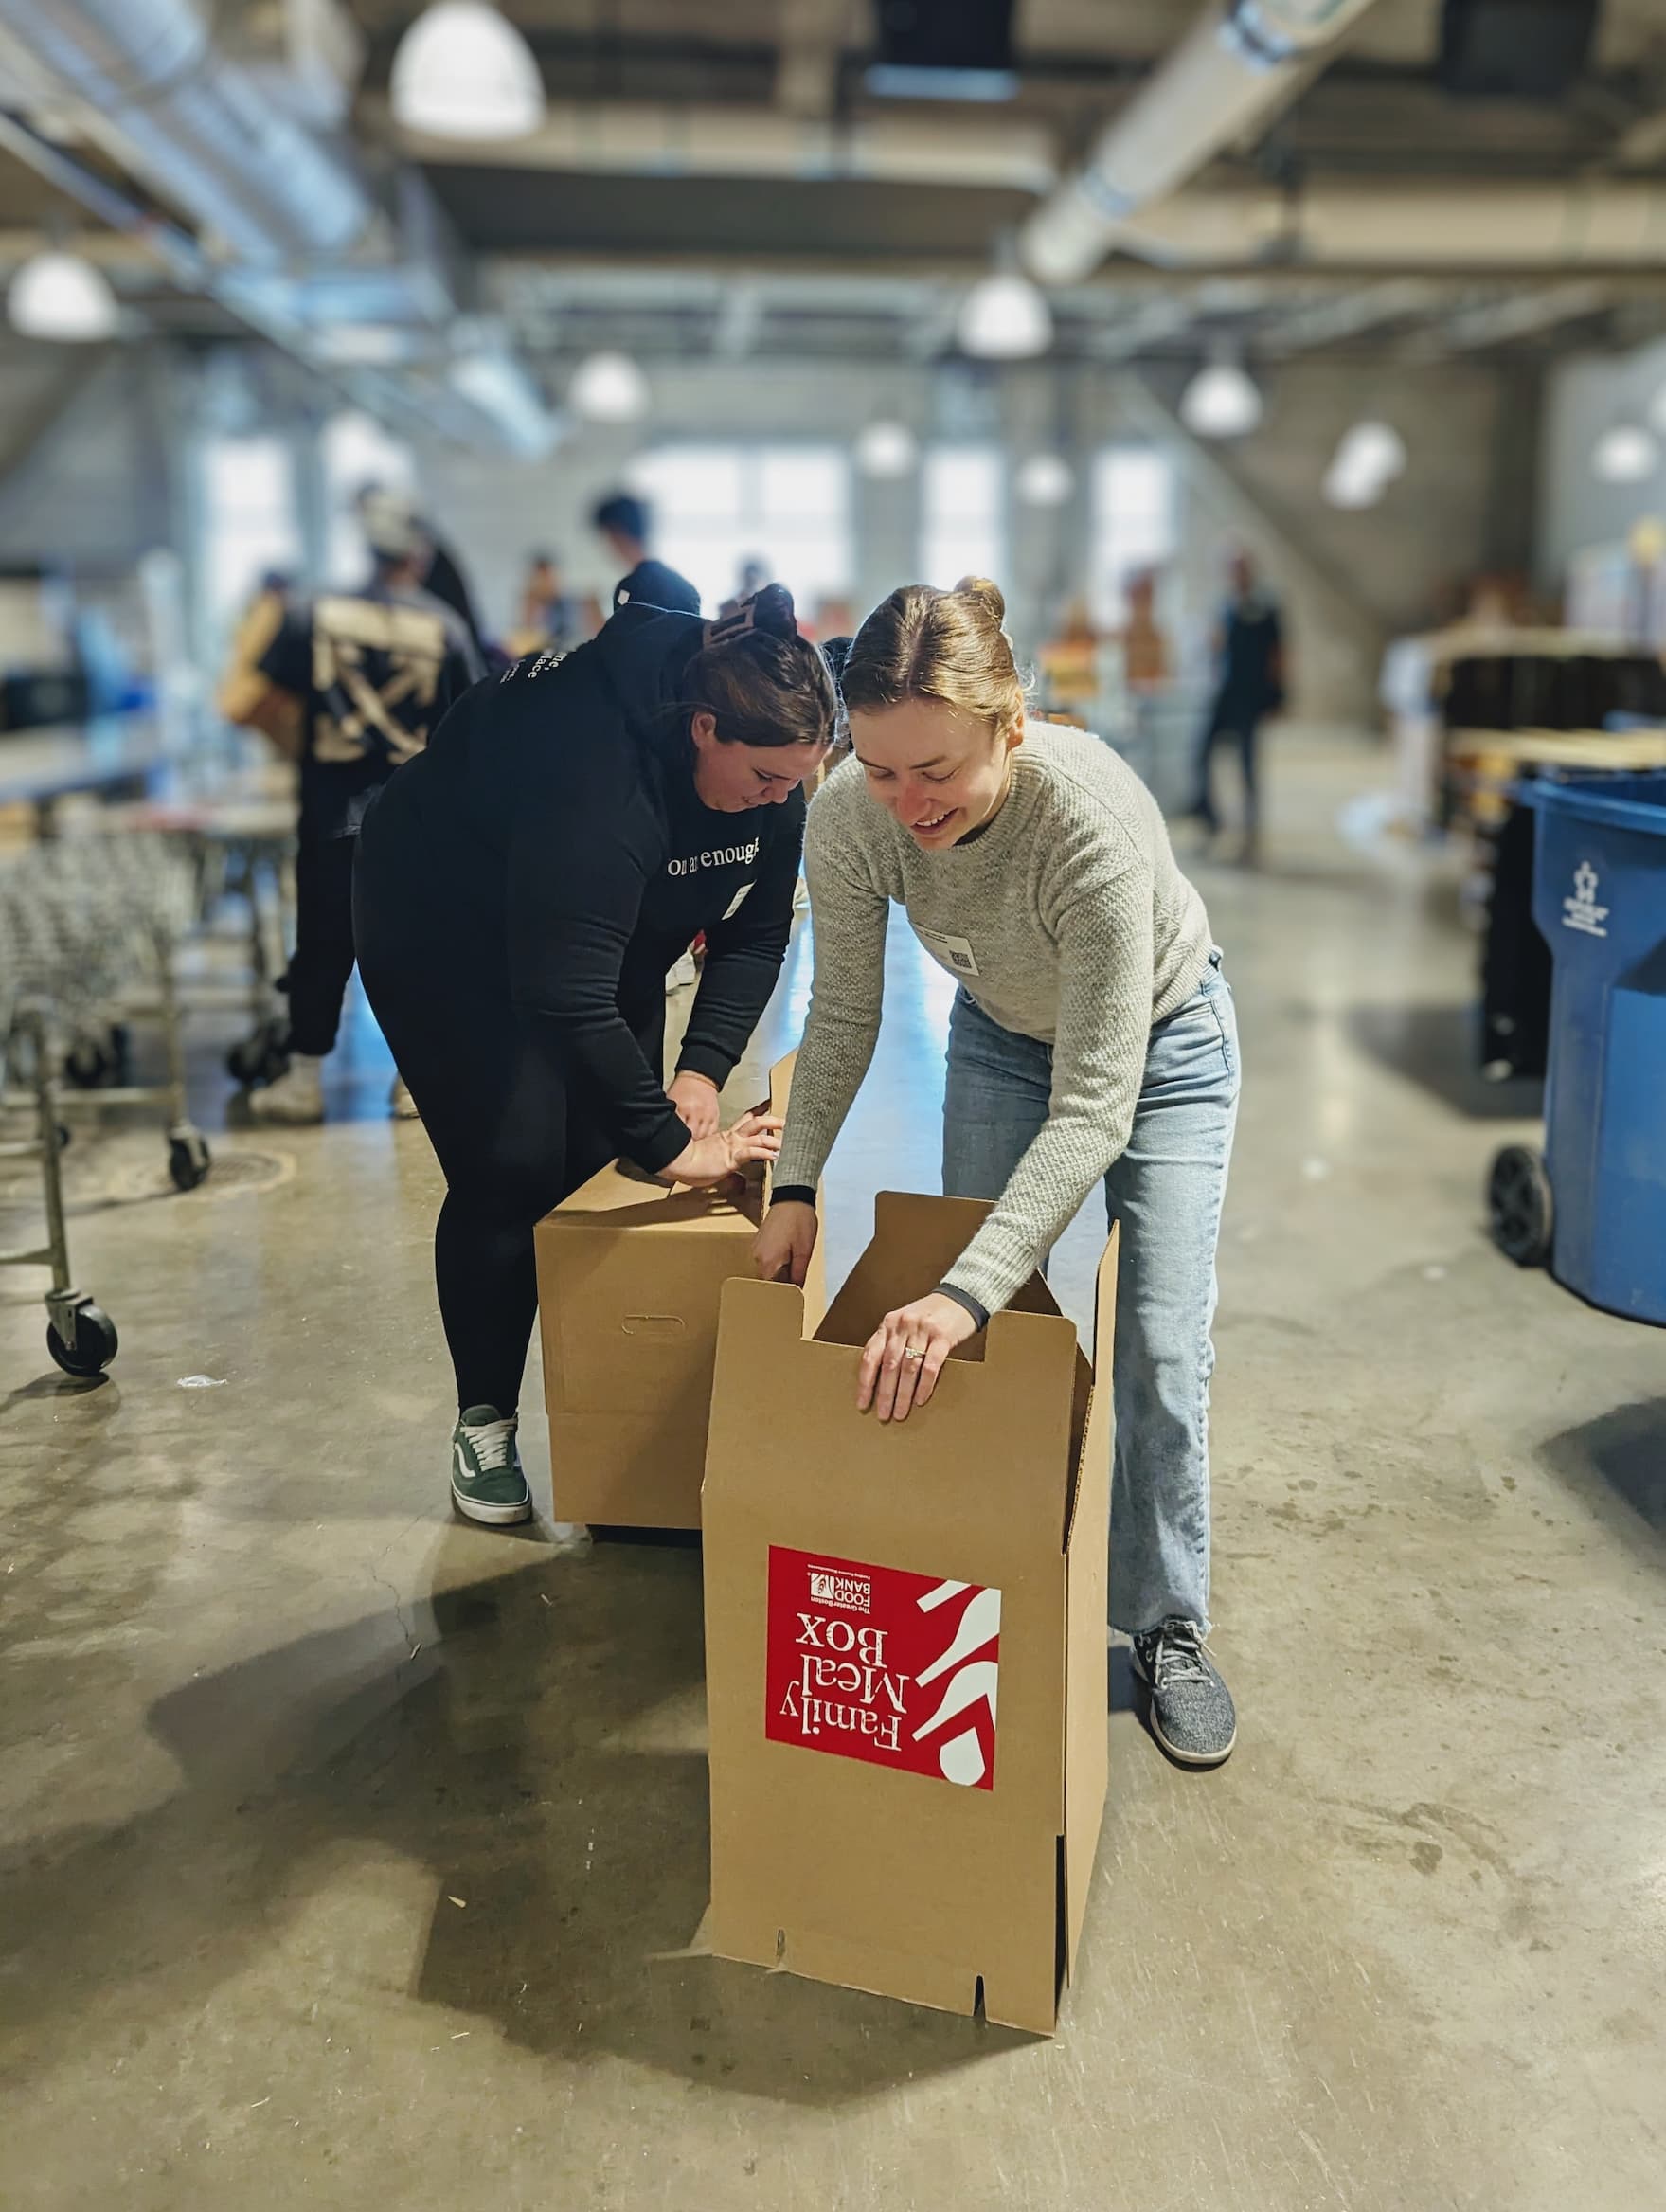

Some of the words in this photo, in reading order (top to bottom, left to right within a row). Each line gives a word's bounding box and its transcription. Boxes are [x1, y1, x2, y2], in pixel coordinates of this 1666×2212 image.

[835, 1576, 870, 1595] BANK
[810, 1596, 833, 1608] Boston
[833, 1601, 858, 1612] Greater
[834, 1590, 870, 1608] FOOD
[858, 1607, 871, 1615] The
[800, 1653, 910, 1714] Meal
[779, 1681, 902, 1752] Family
